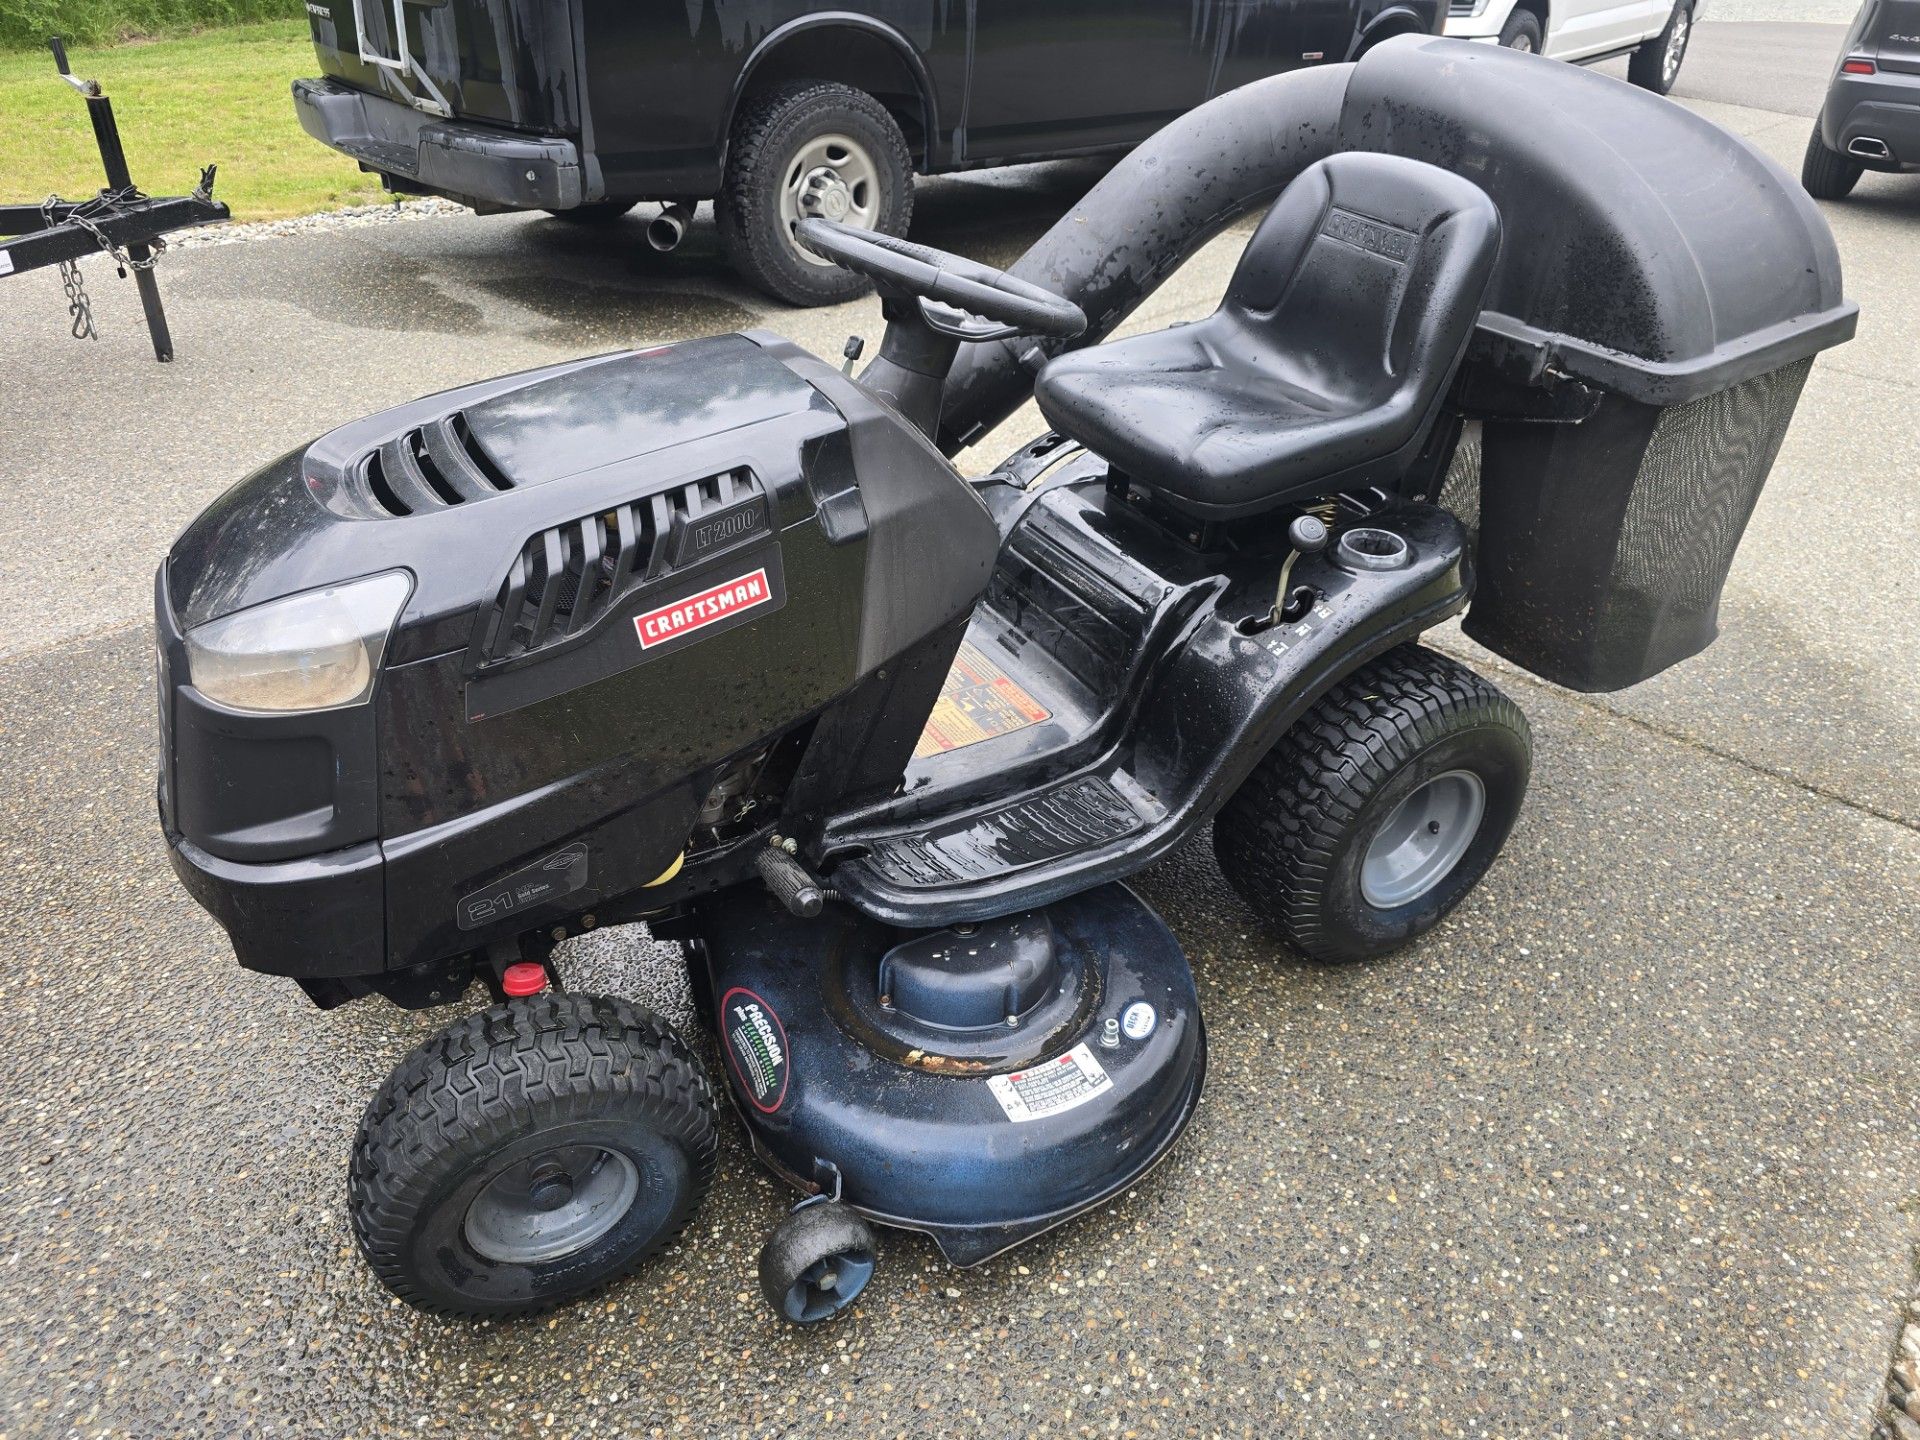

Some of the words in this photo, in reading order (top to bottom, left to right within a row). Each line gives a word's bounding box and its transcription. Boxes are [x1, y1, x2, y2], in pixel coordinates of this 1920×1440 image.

[695, 525, 712, 549] LT
[714, 509, 755, 542] 2000
[645, 579, 761, 638] CRAFTSMAN
[468, 892, 514, 922] 21
[733, 1005, 748, 1022] plus
[745, 1004, 783, 1067] PRECISION
